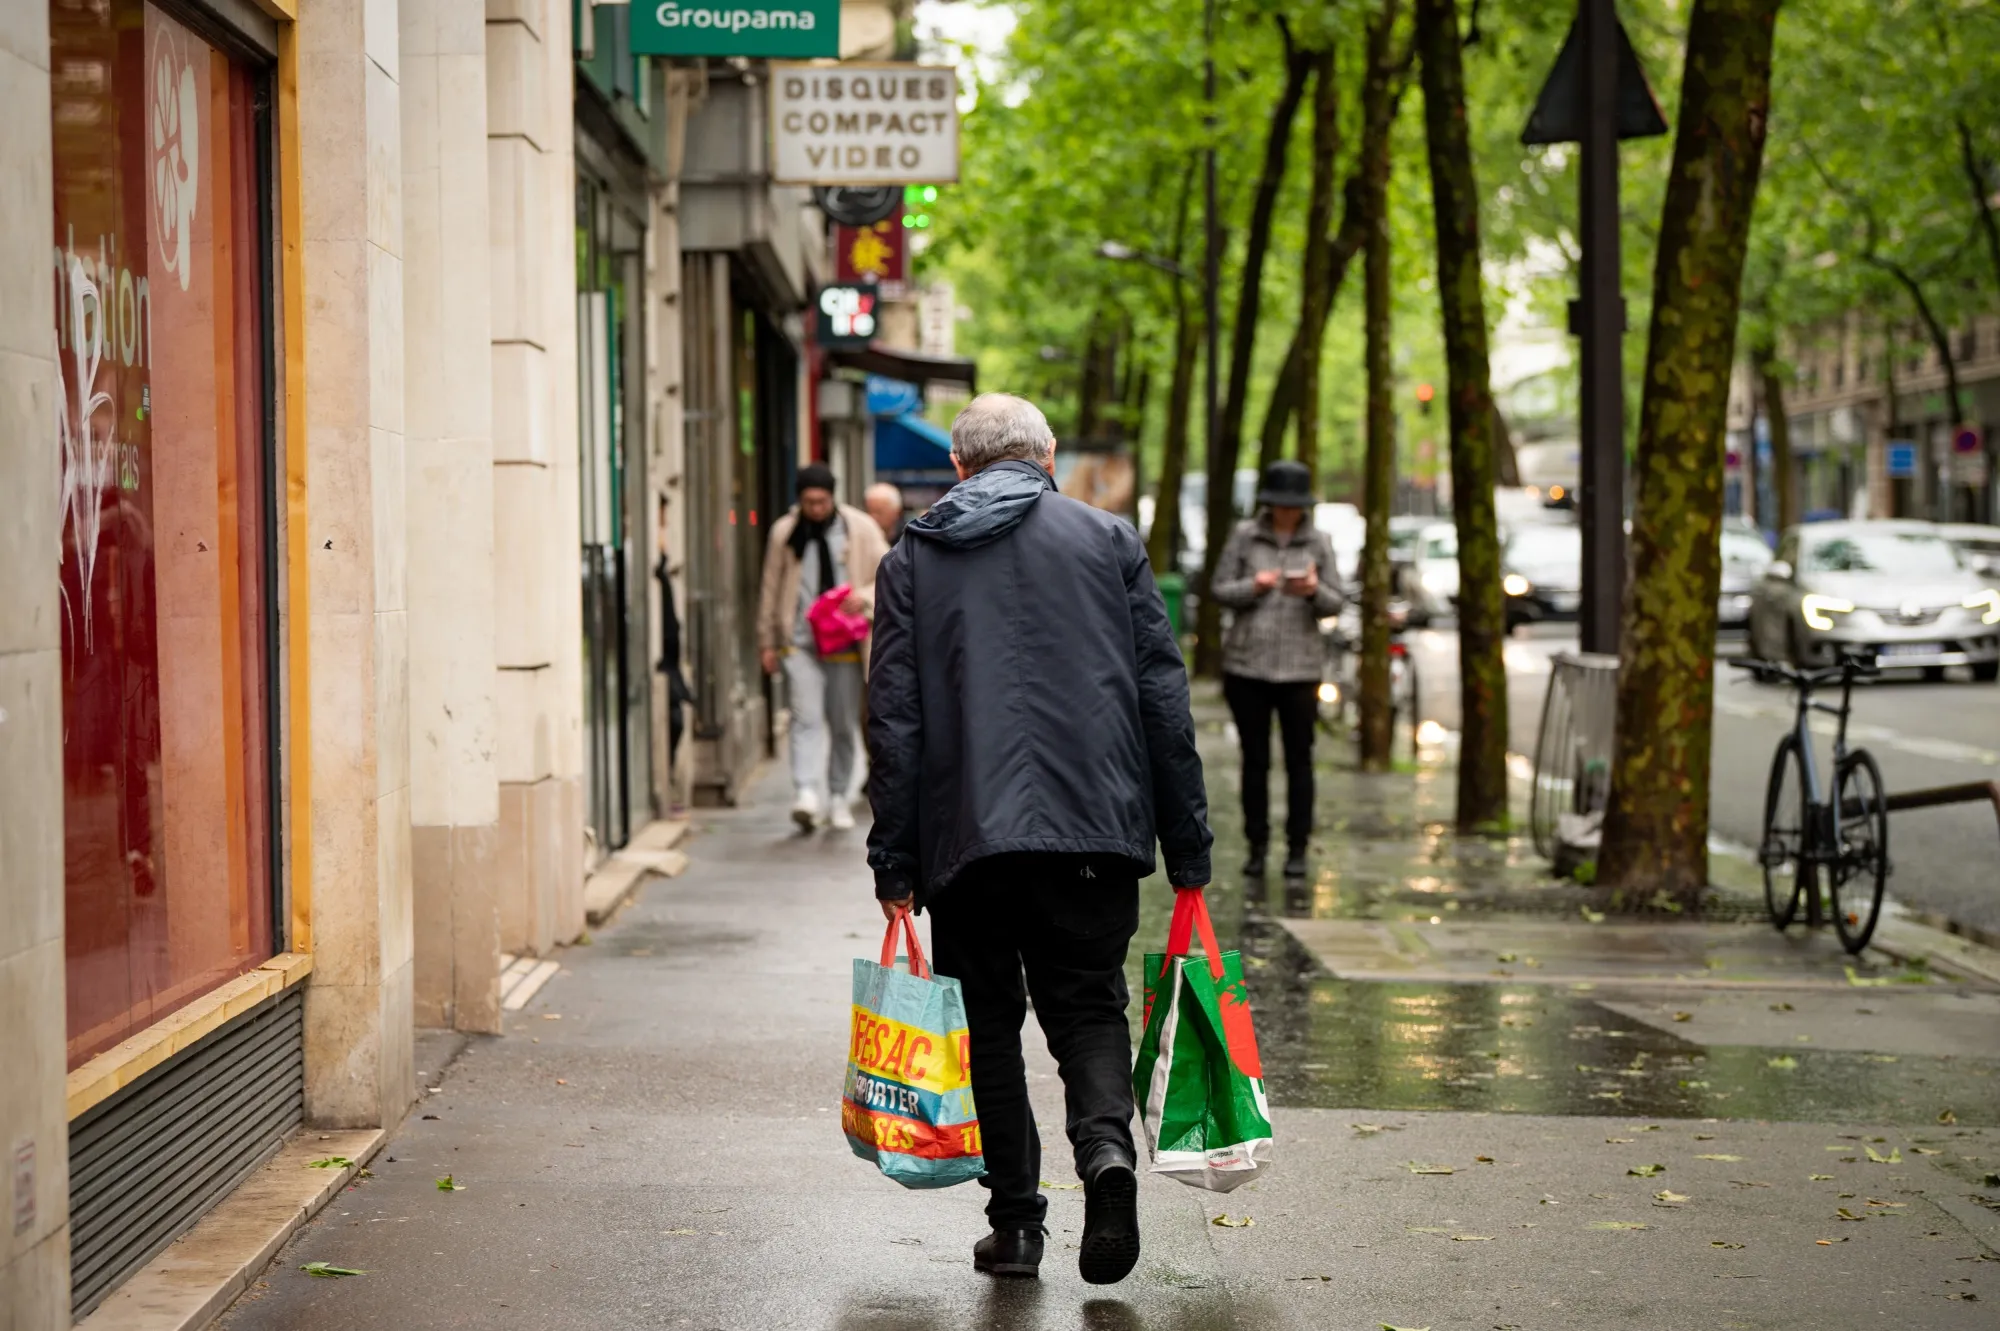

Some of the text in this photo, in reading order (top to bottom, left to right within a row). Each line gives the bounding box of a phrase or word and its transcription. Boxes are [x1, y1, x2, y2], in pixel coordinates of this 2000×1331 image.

[656, 3, 815, 33] Groupama
[785, 78, 947, 101] DISQUES
[783, 111, 948, 135] COMPACT
[804, 145, 921, 170] VIDEO
